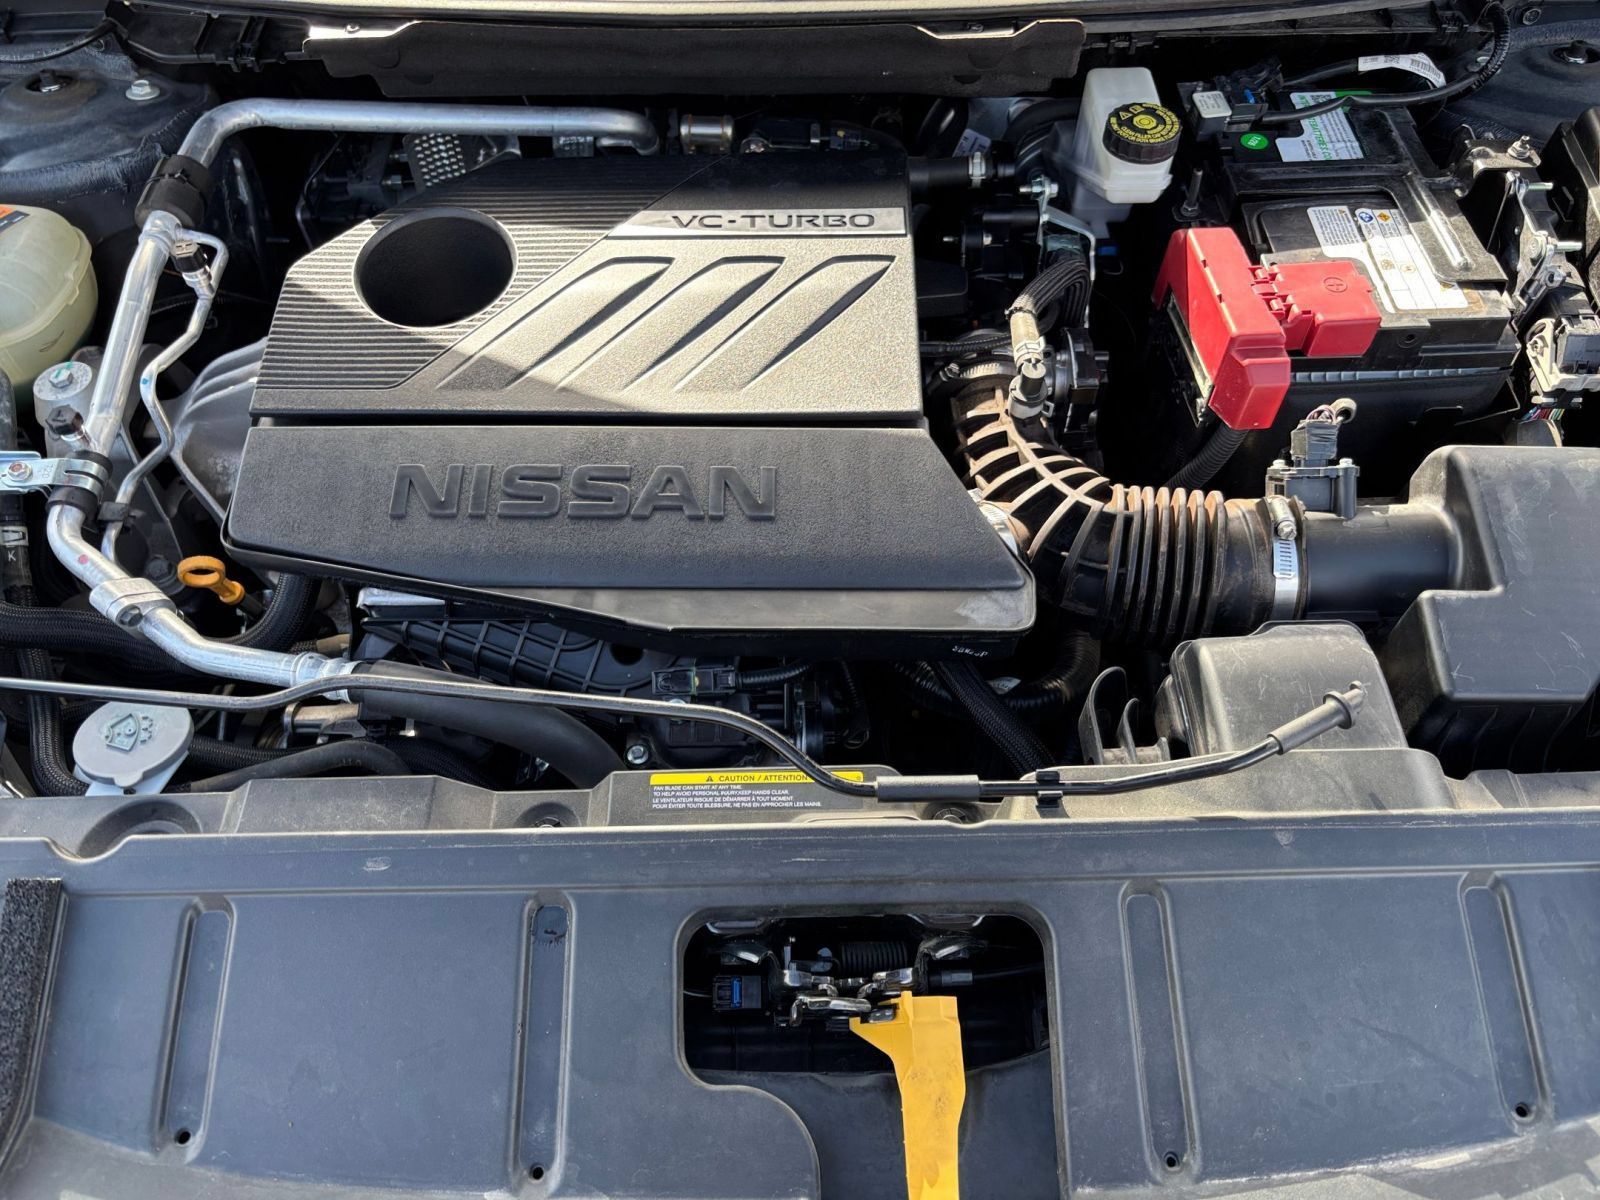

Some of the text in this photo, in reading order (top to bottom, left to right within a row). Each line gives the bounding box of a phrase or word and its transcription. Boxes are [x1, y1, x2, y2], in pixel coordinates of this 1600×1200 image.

[671, 213, 875, 229] VC-TURBO
[388, 463, 778, 520] NISSAN
[7, 550, 17, 562] K
